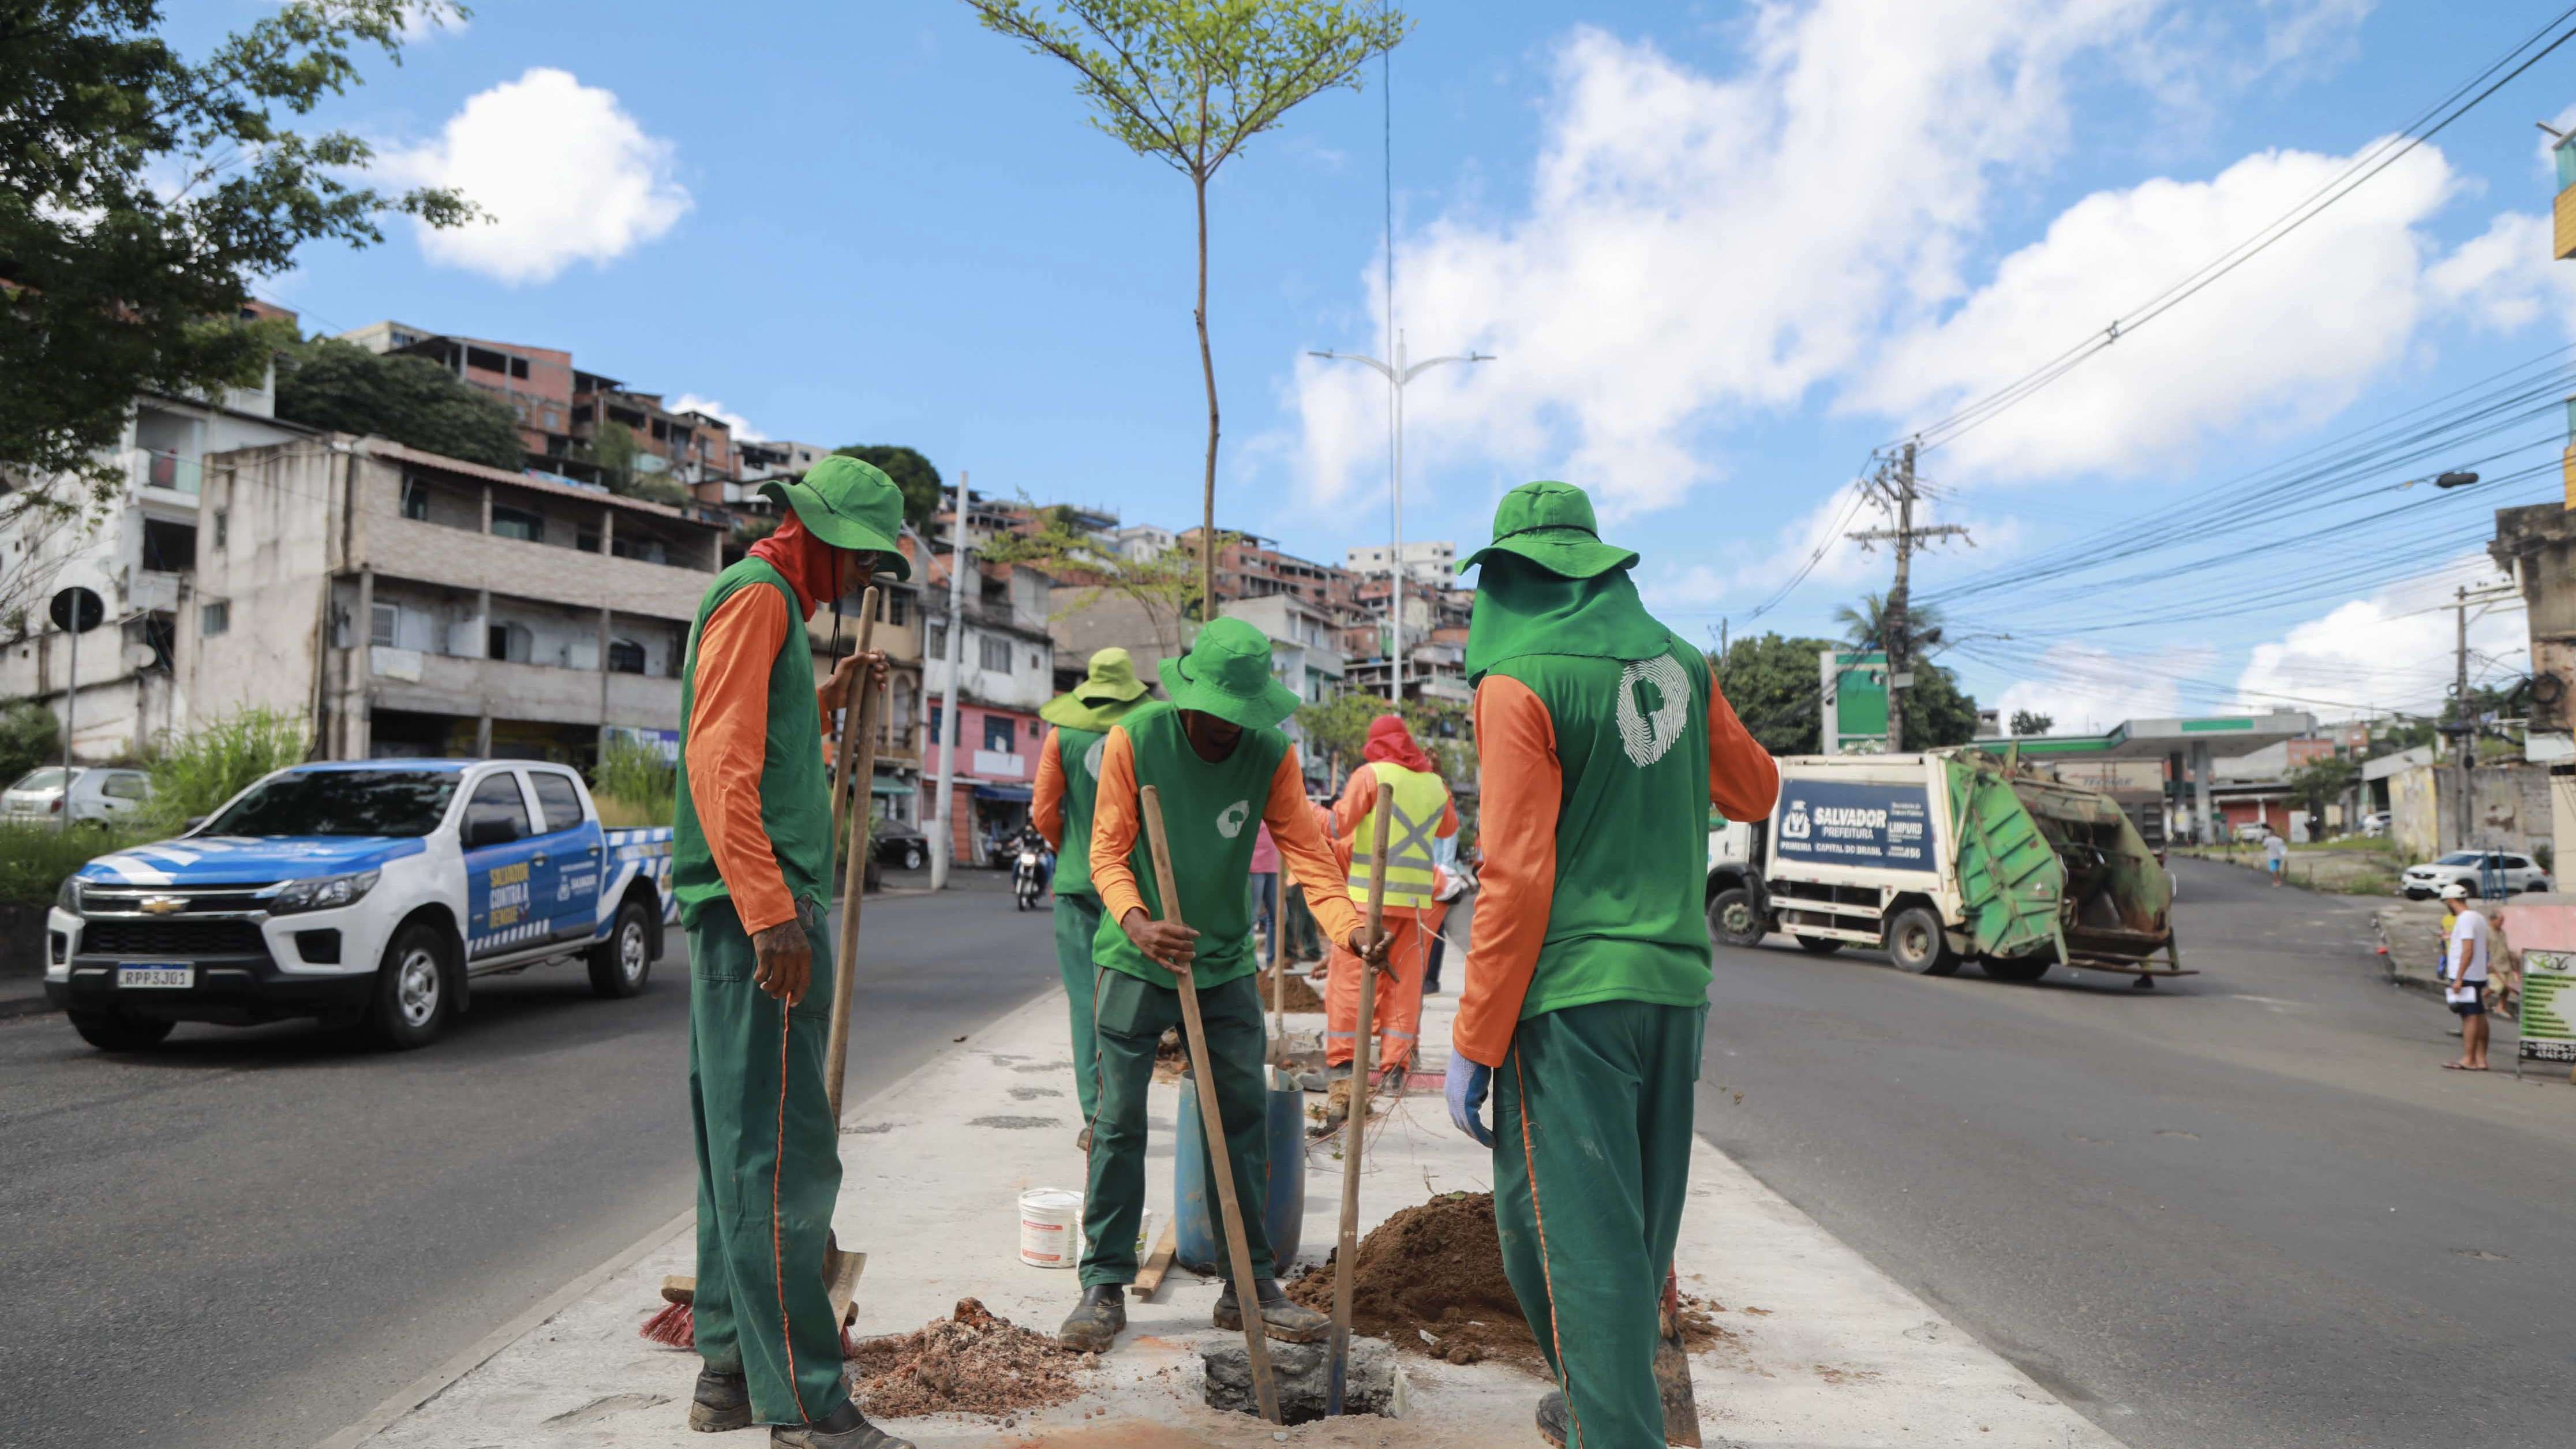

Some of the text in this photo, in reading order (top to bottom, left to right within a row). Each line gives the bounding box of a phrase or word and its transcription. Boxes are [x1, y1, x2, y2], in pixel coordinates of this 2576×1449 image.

[1813, 806, 1887, 828] SALVADOR
[1823, 826, 1874, 840] PREFEITURA
[1889, 821, 1923, 835] LIMPURB
[1780, 841, 1812, 852] PRIMEIRA
[1815, 842, 1844, 854] CAPITAL
[1846, 845, 1855, 855] DO
[1856, 845, 1882, 857] BRASIL
[489, 862, 530, 888] SALVADOR
[490, 883, 522, 910] CONTRA
[489, 905, 519, 930] DENGUE
[126, 971, 185, 986] RPP3J01
